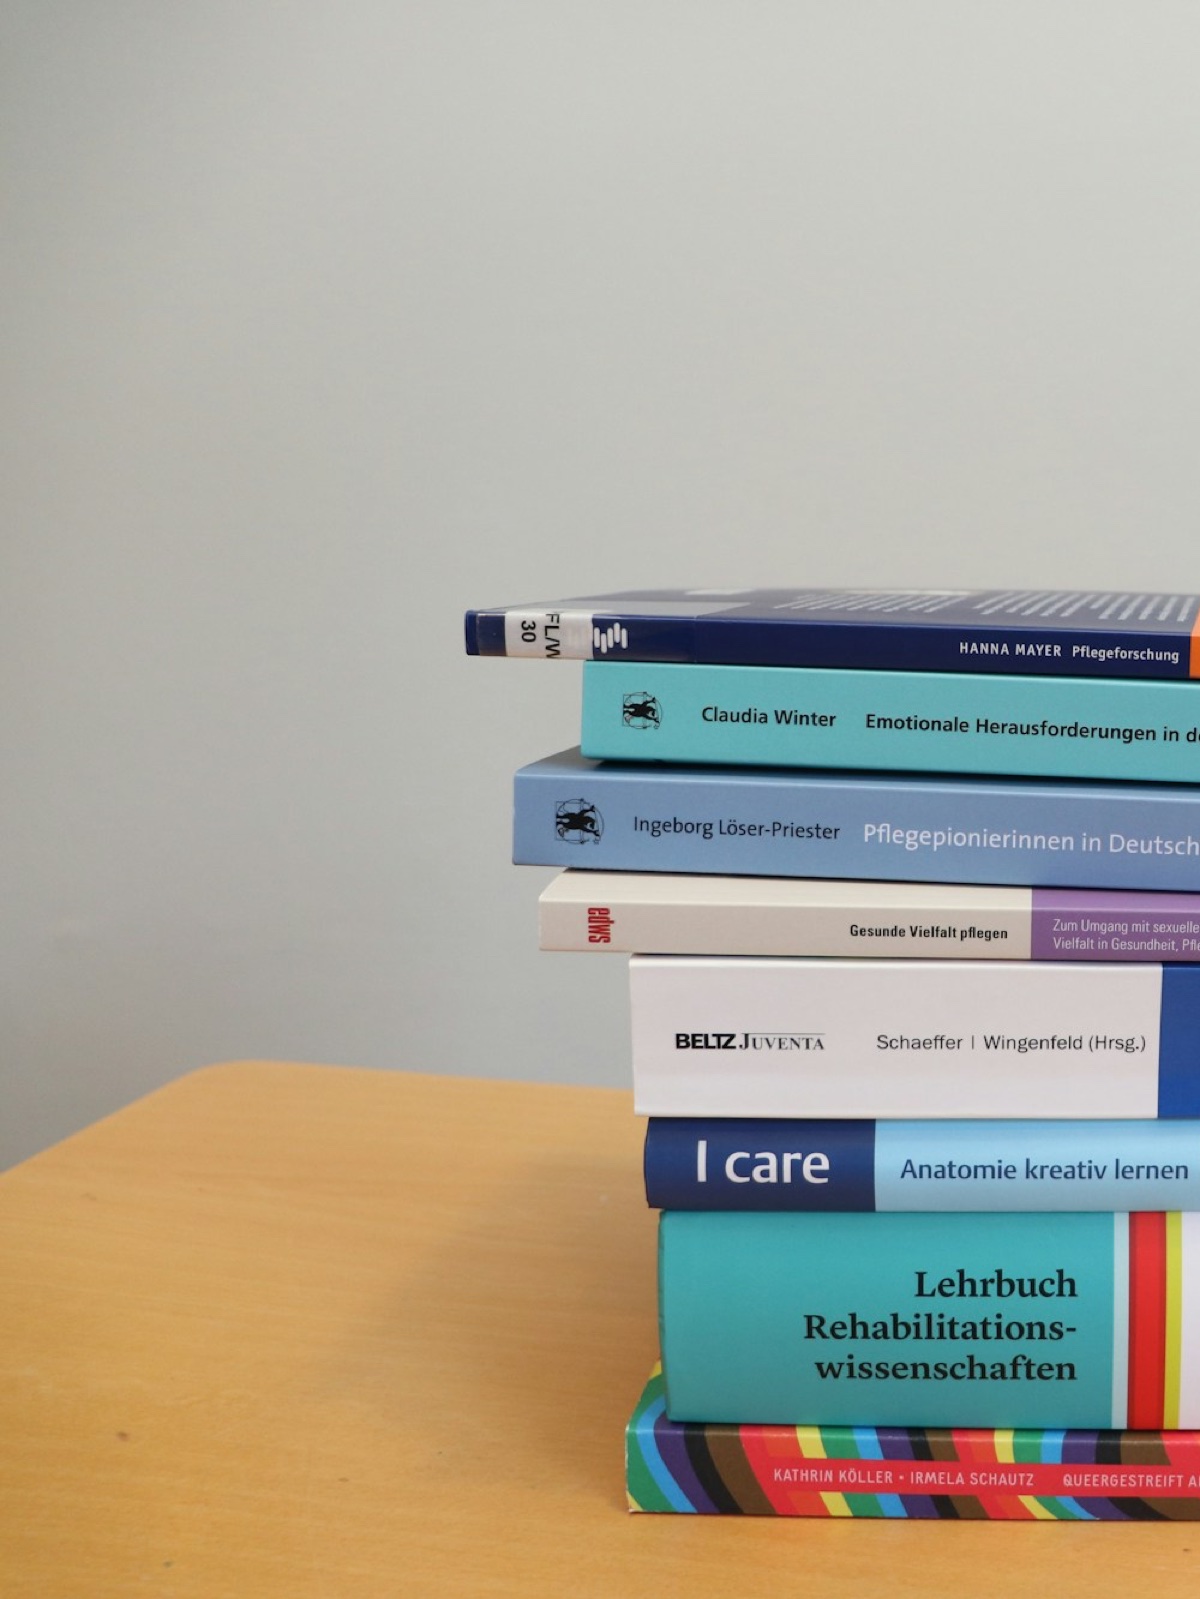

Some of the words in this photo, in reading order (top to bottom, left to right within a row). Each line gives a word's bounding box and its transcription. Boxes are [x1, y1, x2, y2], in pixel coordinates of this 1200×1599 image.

[521, 621, 536, 642] 30
[959, 642, 1010, 655] HANNA
[1015, 644, 1062, 657] MAYER
[1072, 645, 1180, 663] Pflegeforschung
[702, 706, 768, 724] Claudia
[774, 710, 836, 727] Winter
[865, 713, 969, 733] Emotionale
[975, 718, 1157, 743] Herausforderungen
[1163, 726, 1180, 741] in
[633, 816, 714, 838] Ingeborg
[718, 819, 841, 840] Löser-Priester
[864, 822, 1074, 852] Pflegepionierinnen
[1082, 833, 1101, 852] in
[850, 924, 906, 938] Gesunde
[910, 925, 957, 940] Vielfalt
[960, 926, 1008, 942] pflegen
[1053, 919, 1077, 933] Zum
[1081, 919, 1128, 936] Umgang
[1132, 920, 1150, 934] mit
[1053, 936, 1094, 951] Vielfalt
[1098, 937, 1109, 951] in
[1112, 937, 1179, 954] Gesundheit,
[675, 1033, 736, 1050] BELTZ
[876, 1035, 963, 1050] Schaeffer
[983, 1035, 1083, 1053] Wingenfeld
[1088, 1035, 1147, 1053] (Hrsg.)
[696, 1140, 707, 1182] I
[724, 1151, 830, 1184] care
[900, 1158, 1017, 1181] Anatomie
[1024, 1159, 1108, 1181] kreativ
[1114, 1159, 1190, 1182] lernen
[914, 1268, 1078, 1299] Lehrbuch
[804, 1313, 1078, 1342] Rehabilitations-
[814, 1355, 1077, 1381] wissenschaften
[773, 1468, 834, 1484] KATHRIN
[838, 1467, 893, 1484] KÖLLER
[910, 1470, 965, 1485] IRMELA
[969, 1471, 1034, 1486] SCHAUTZ
[1062, 1472, 1184, 1488] QUEERGESTREIFT
